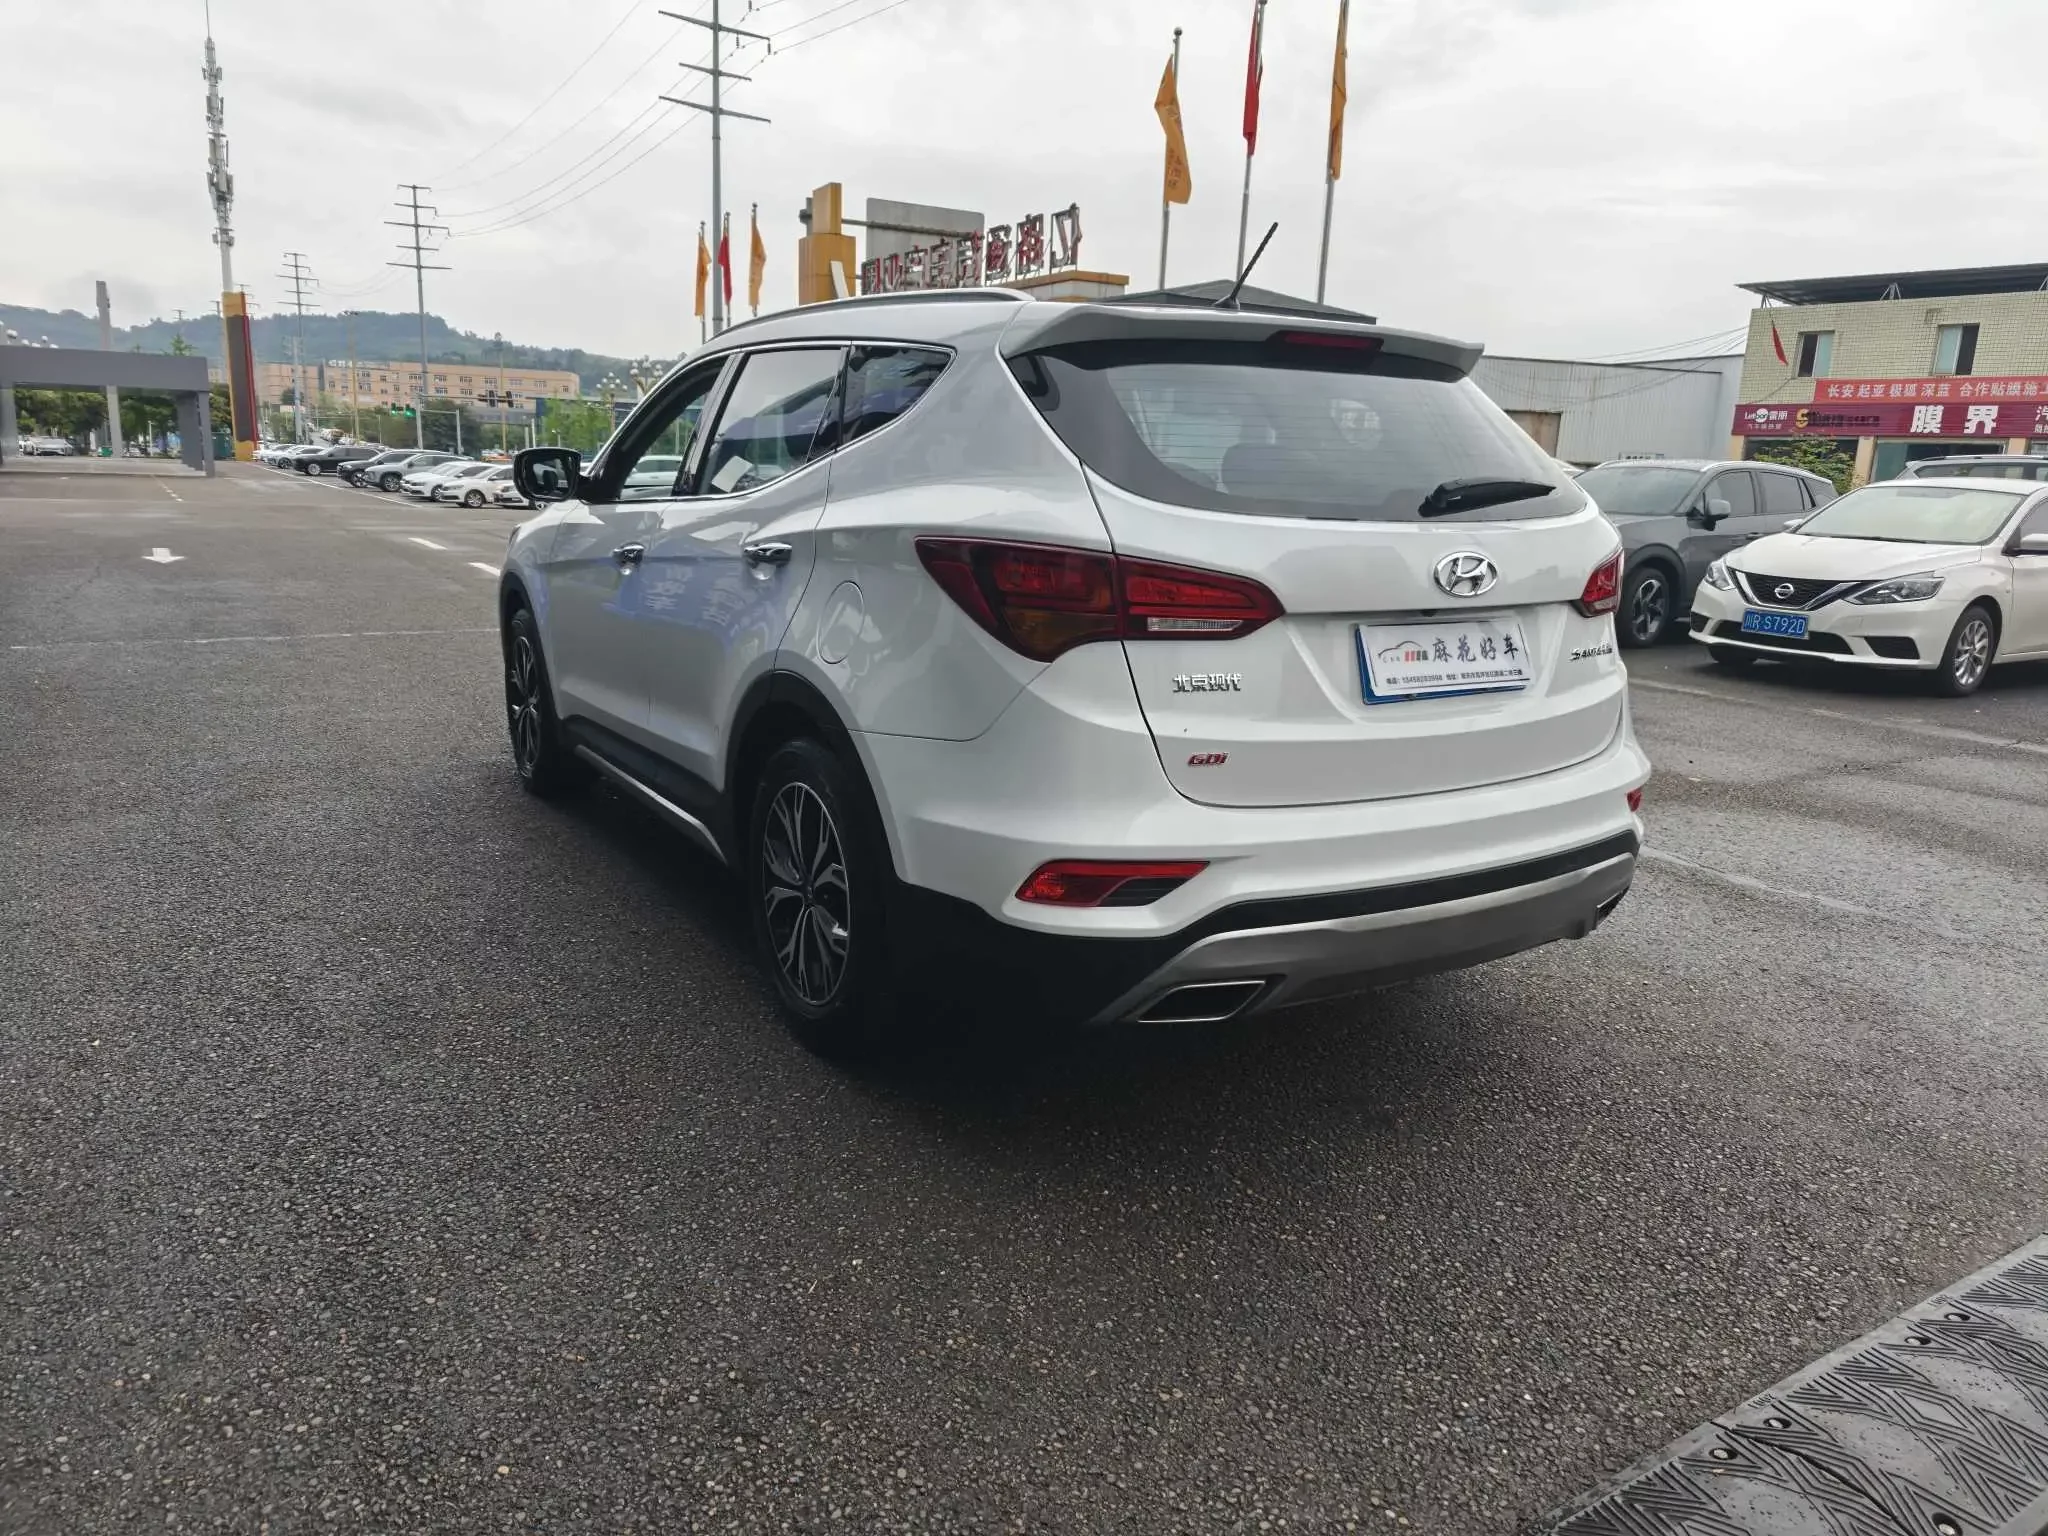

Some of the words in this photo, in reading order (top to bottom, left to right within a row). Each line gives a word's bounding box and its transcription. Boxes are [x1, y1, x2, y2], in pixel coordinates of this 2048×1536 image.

[1909, 405, 1999, 434] 膜界
[1432, 633, 1519, 663] 麻花好车
[1172, 673, 1242, 693] 北京现代
